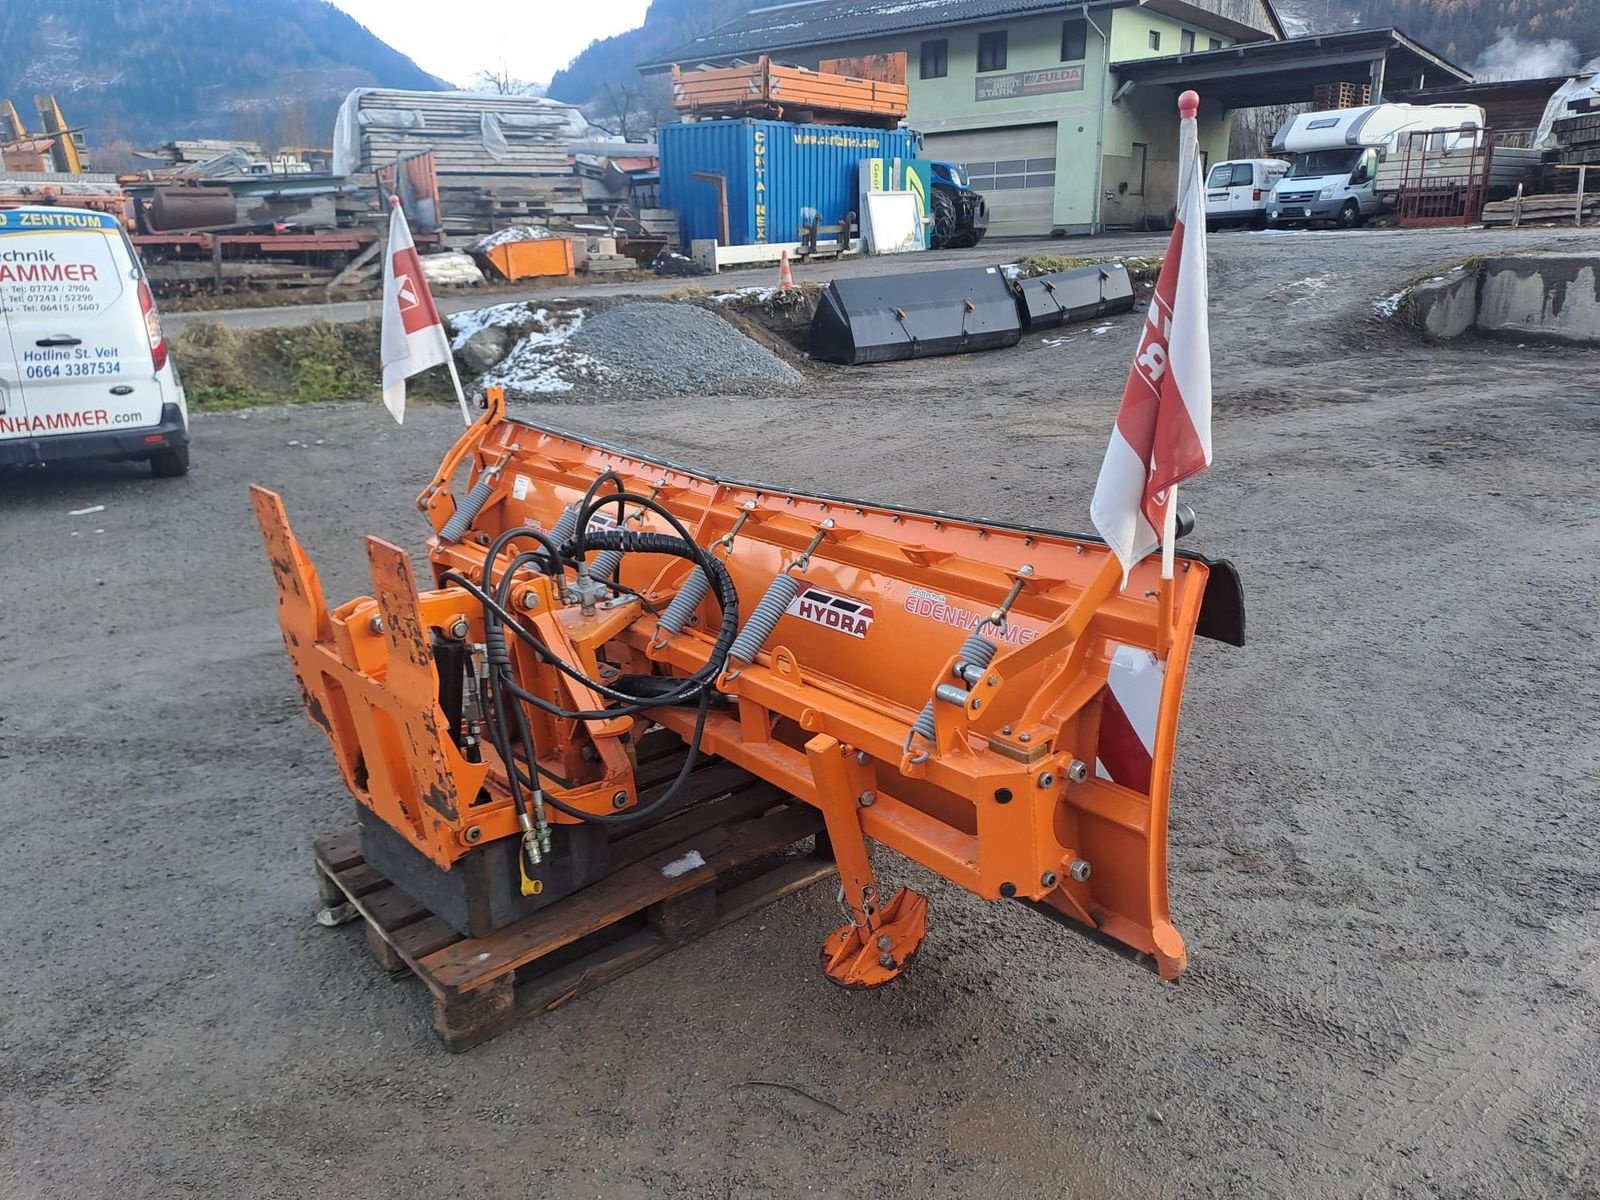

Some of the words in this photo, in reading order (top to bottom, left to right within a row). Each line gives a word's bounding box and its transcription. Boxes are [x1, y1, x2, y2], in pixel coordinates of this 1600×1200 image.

[1036, 69, 1080, 83] FULDA
[20, 213, 102, 228] ZENTRUM
[11, 285, 27, 293] Tel:
[9, 295, 24, 303] Tel:
[23, 305, 37, 313] Tel:
[24, 350, 71, 362] Hotline
[74, 348, 91, 359] St.
[95, 347, 118, 358] Veit
[27, 364, 60, 378] 0664
[65, 361, 121, 376] 3387534
[799, 600, 869, 635] HYDRA
